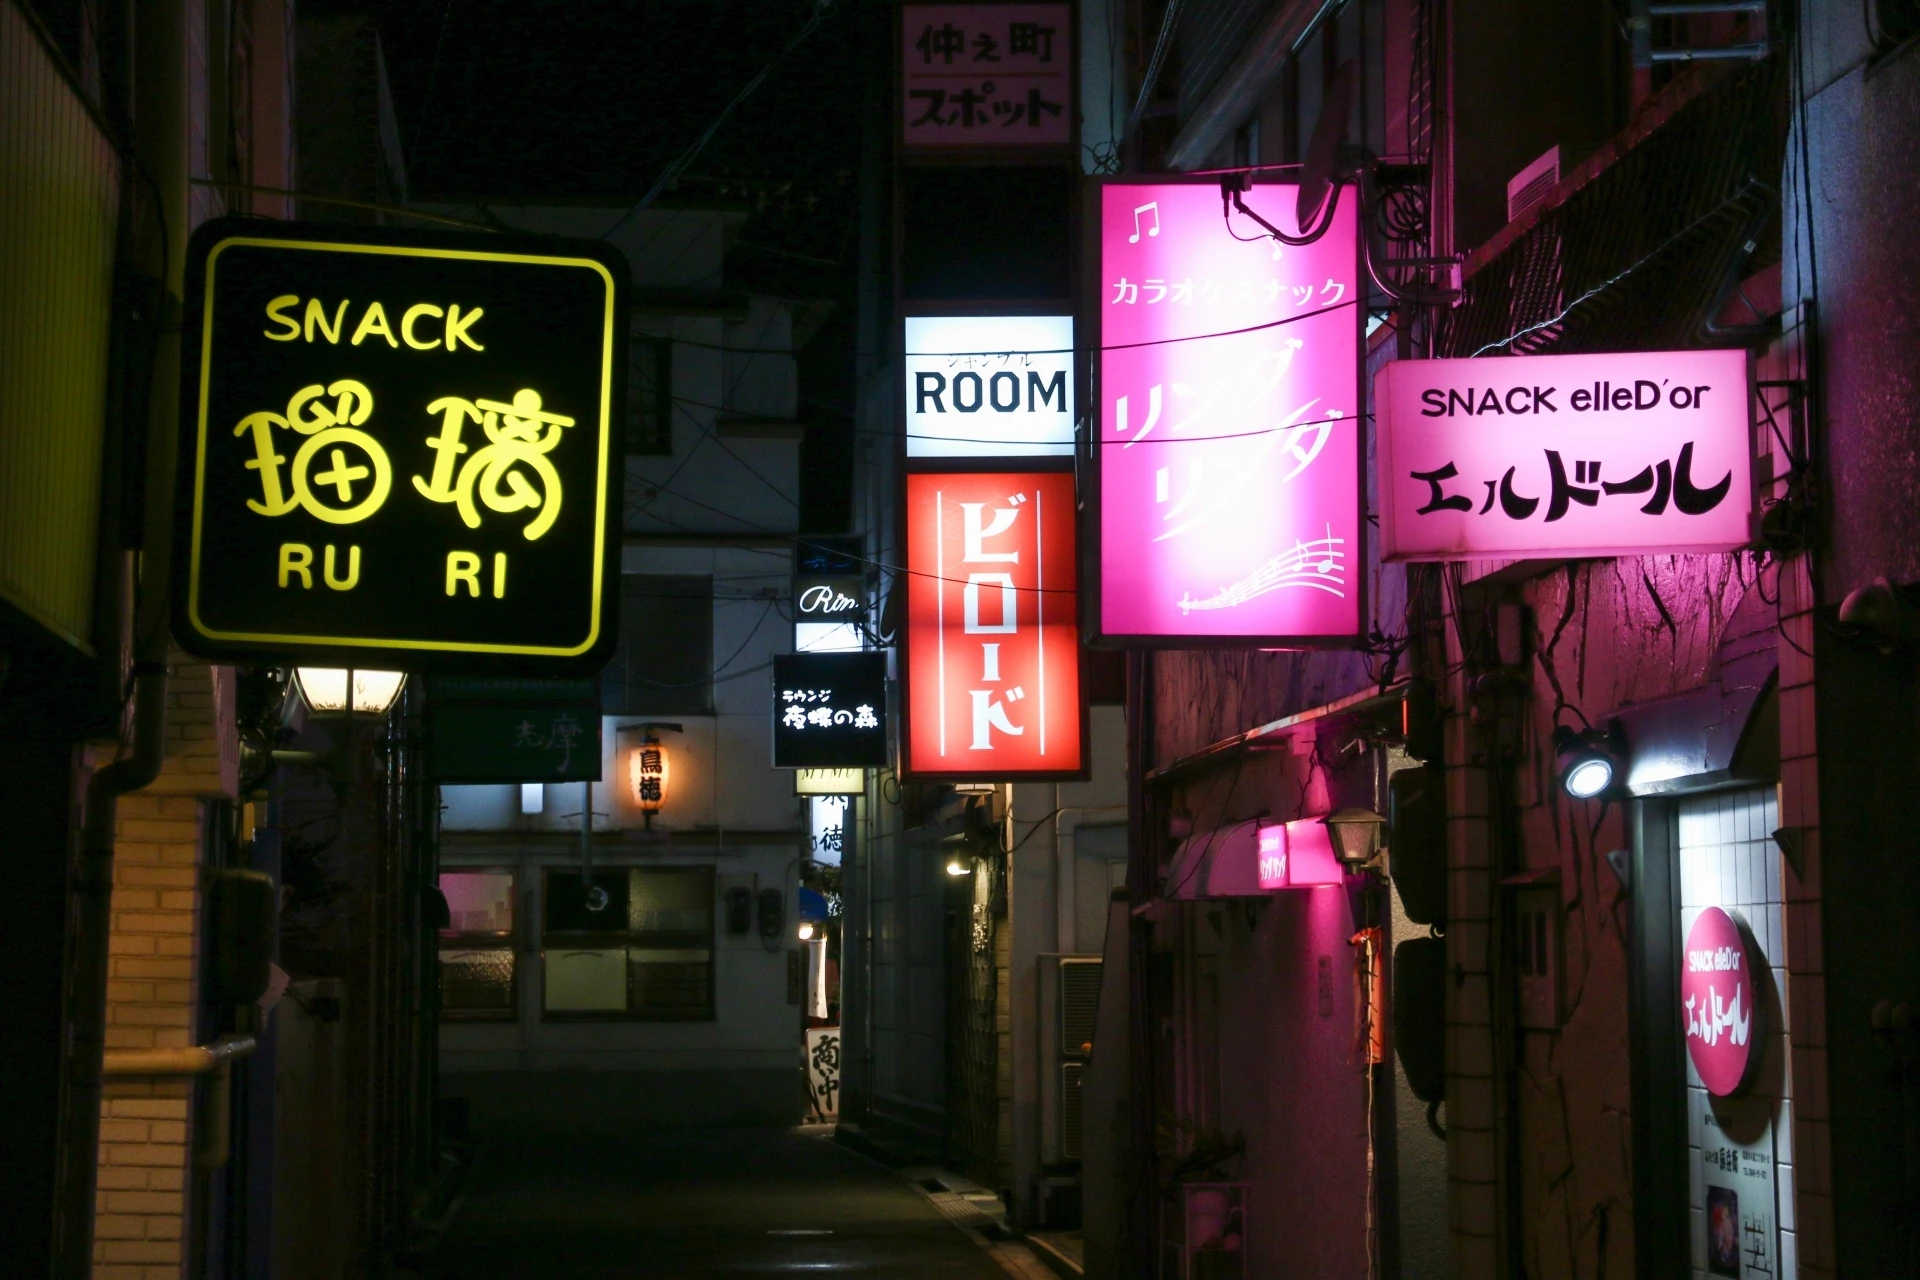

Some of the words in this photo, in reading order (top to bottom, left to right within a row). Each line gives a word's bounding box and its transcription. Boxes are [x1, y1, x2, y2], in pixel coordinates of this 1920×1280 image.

[909, 80, 1064, 128] スポット
[1112, 277, 1345, 307] カラオケスナック
[263, 294, 485, 352] SNACK
[914, 370, 1068, 414] ROOM
[1420, 385, 1558, 418] SNACK
[1410, 440, 1732, 523] エルドール
[278, 543, 361, 591] RU
[446, 551, 507, 599] RI
[959, 492, 1027, 750] ビロード
[782, 689, 832, 703] ラウンジ
[1689, 949, 1714, 972] SNACK
[1684, 982, 1749, 1047] エルドール
[811, 1034, 840, 1112] 商い中
